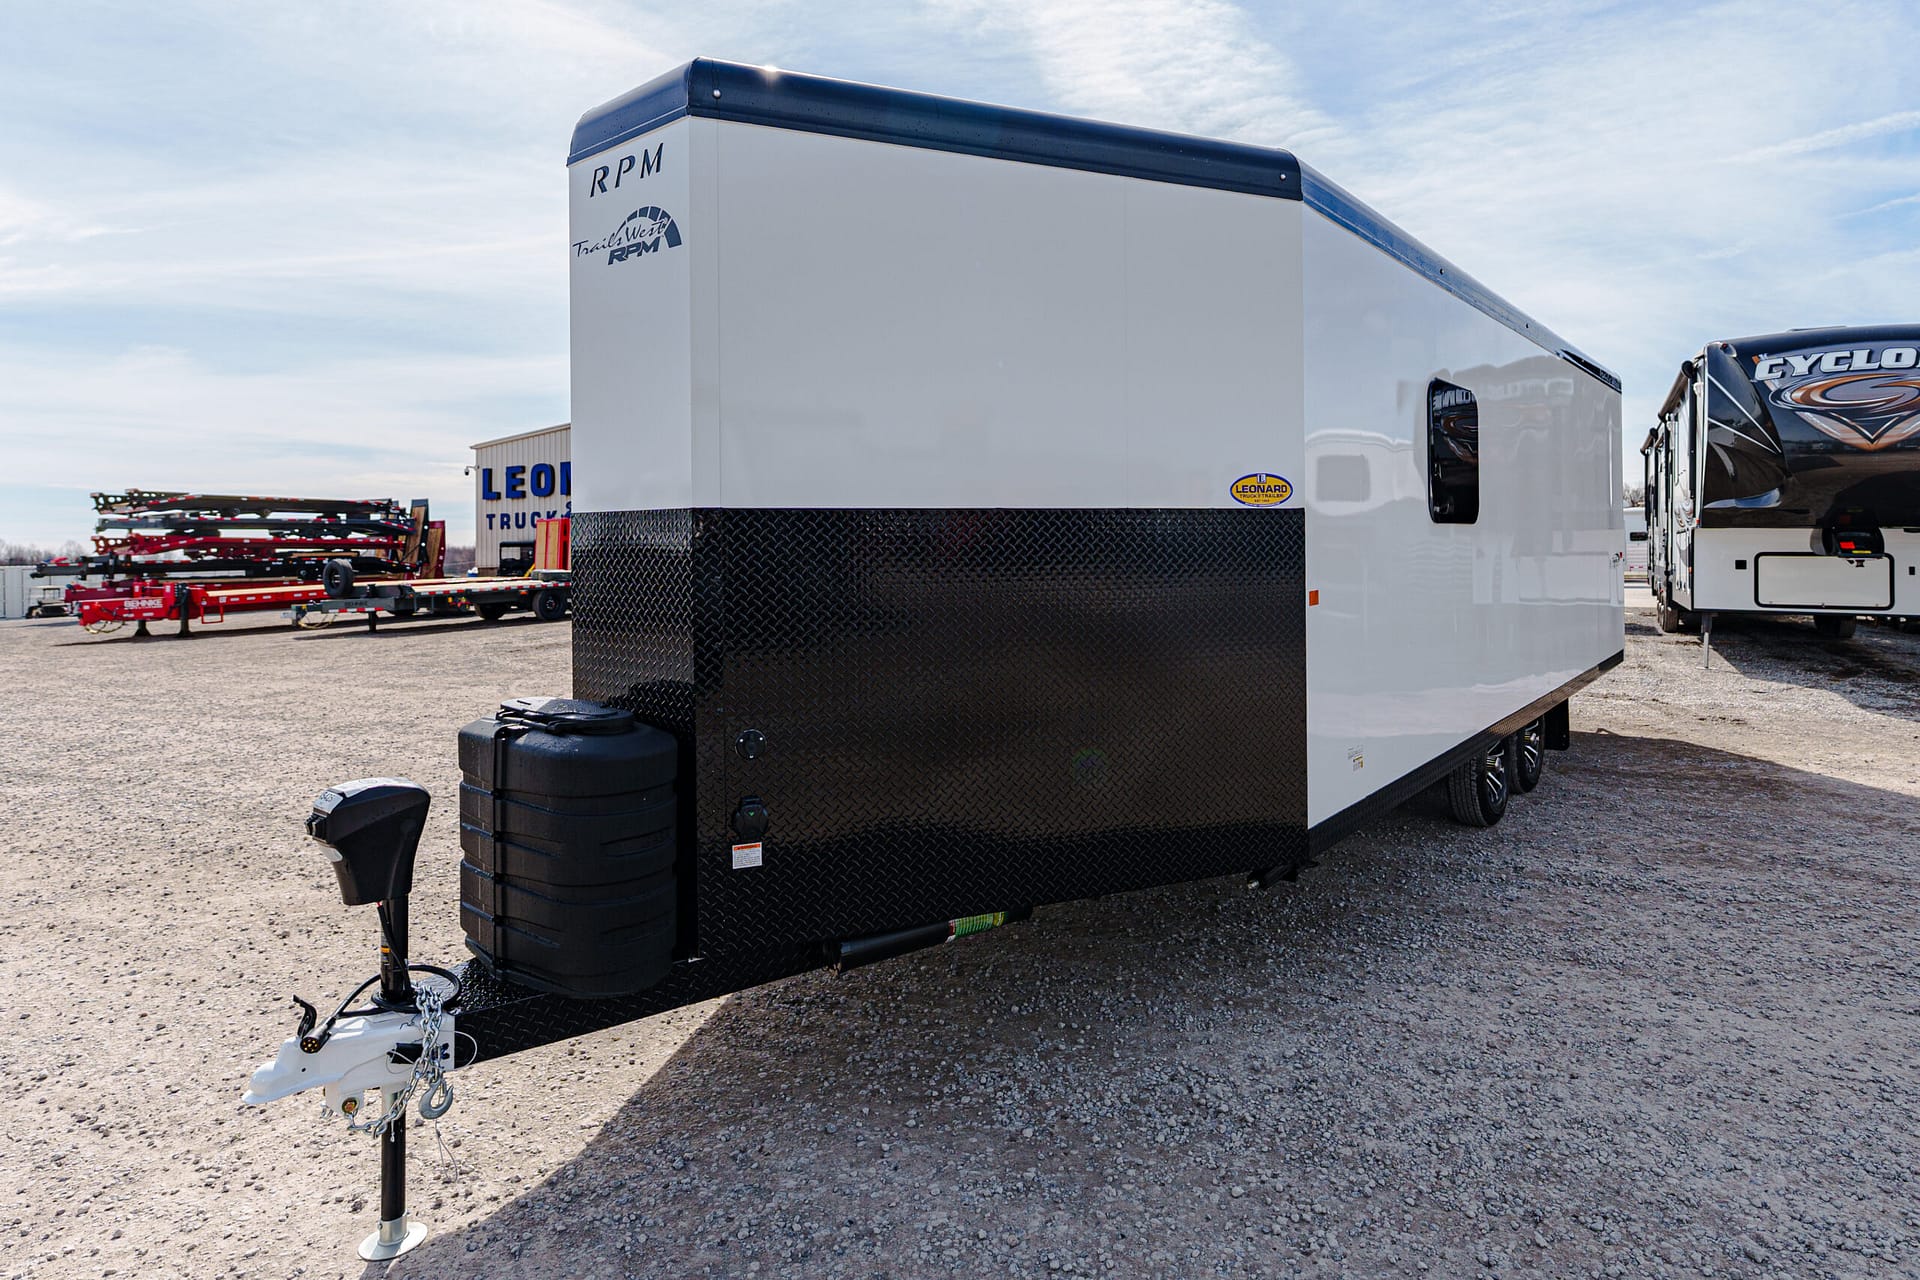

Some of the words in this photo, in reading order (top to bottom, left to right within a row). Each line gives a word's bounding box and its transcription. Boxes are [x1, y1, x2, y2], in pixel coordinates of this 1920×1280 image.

[589, 142, 664, 198] RPM
[572, 220, 626, 257] Trails
[625, 220, 666, 242] West
[608, 236, 661, 266] RPM
[1755, 347, 1920, 381] CYCLO
[1236, 485, 1287, 493] LEONARD
[123, 600, 163, 609] BEHNKE
